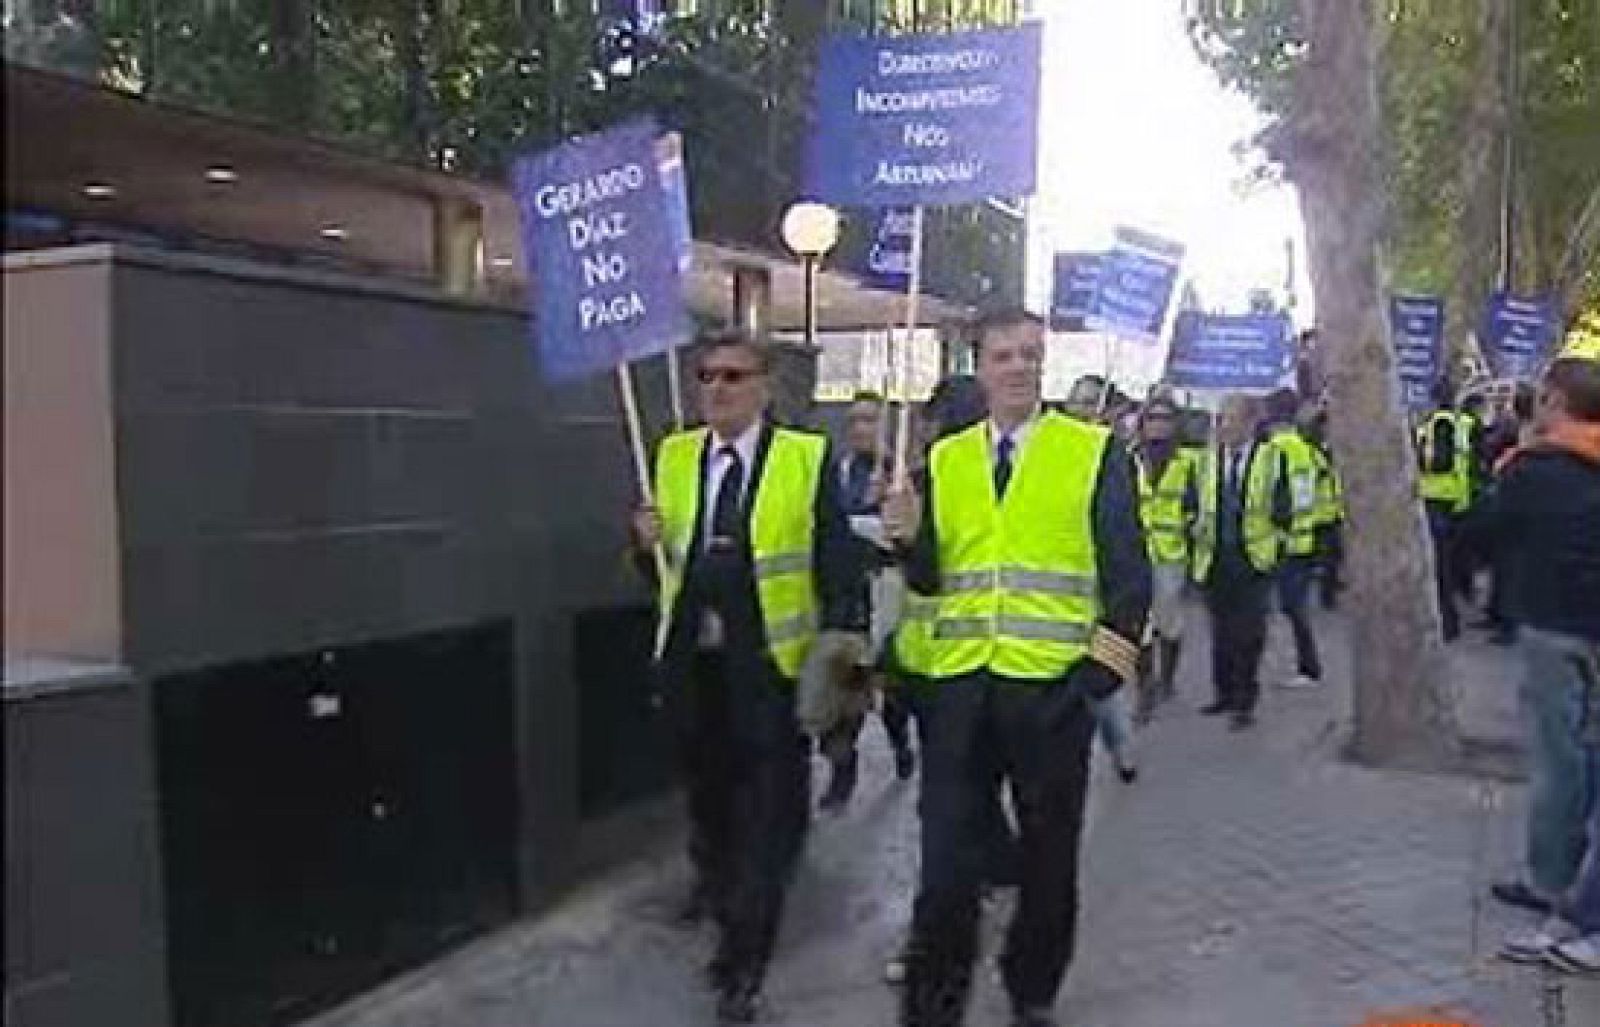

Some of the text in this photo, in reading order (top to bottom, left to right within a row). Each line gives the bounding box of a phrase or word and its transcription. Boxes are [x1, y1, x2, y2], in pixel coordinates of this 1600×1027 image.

[535, 163, 643, 218] GERARDO
[584, 253, 625, 286] NO
[579, 291, 646, 329] PAGA
